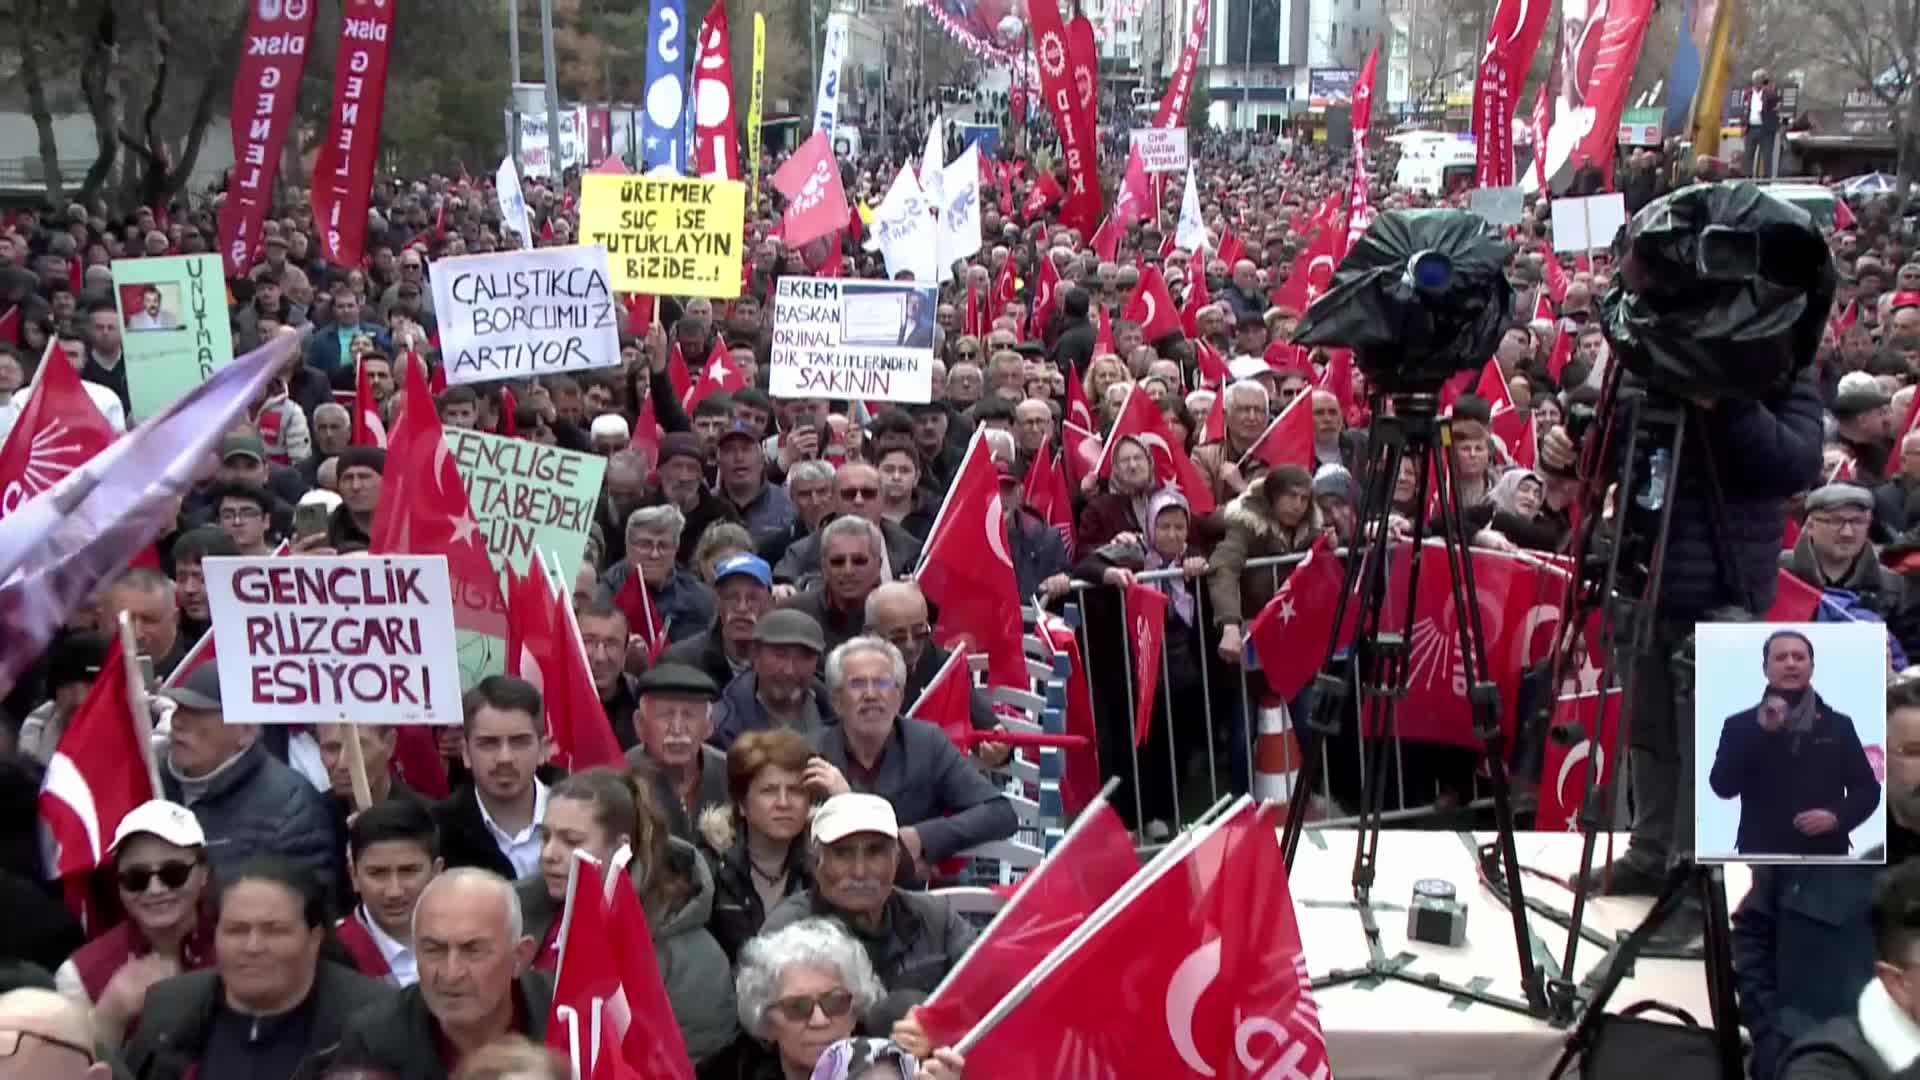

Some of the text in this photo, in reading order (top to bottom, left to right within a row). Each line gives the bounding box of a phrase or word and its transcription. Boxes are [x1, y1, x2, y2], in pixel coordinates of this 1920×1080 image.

[620, 182, 716, 205] ÜRETMEK
[619, 208, 706, 235] SUÇ İSE
[592, 232, 732, 256] TUTUKLAYIN
[452, 267, 609, 305] ÇALIŞTIKÇA
[778, 279, 838, 301] EKREM
[472, 303, 616, 336] BORCUMUZ
[454, 337, 591, 373] ARTIYOR
[796, 367, 890, 395] SAKININ
[231, 559, 430, 612] GENÇLİK
[246, 611, 423, 656] RÜZGARI
